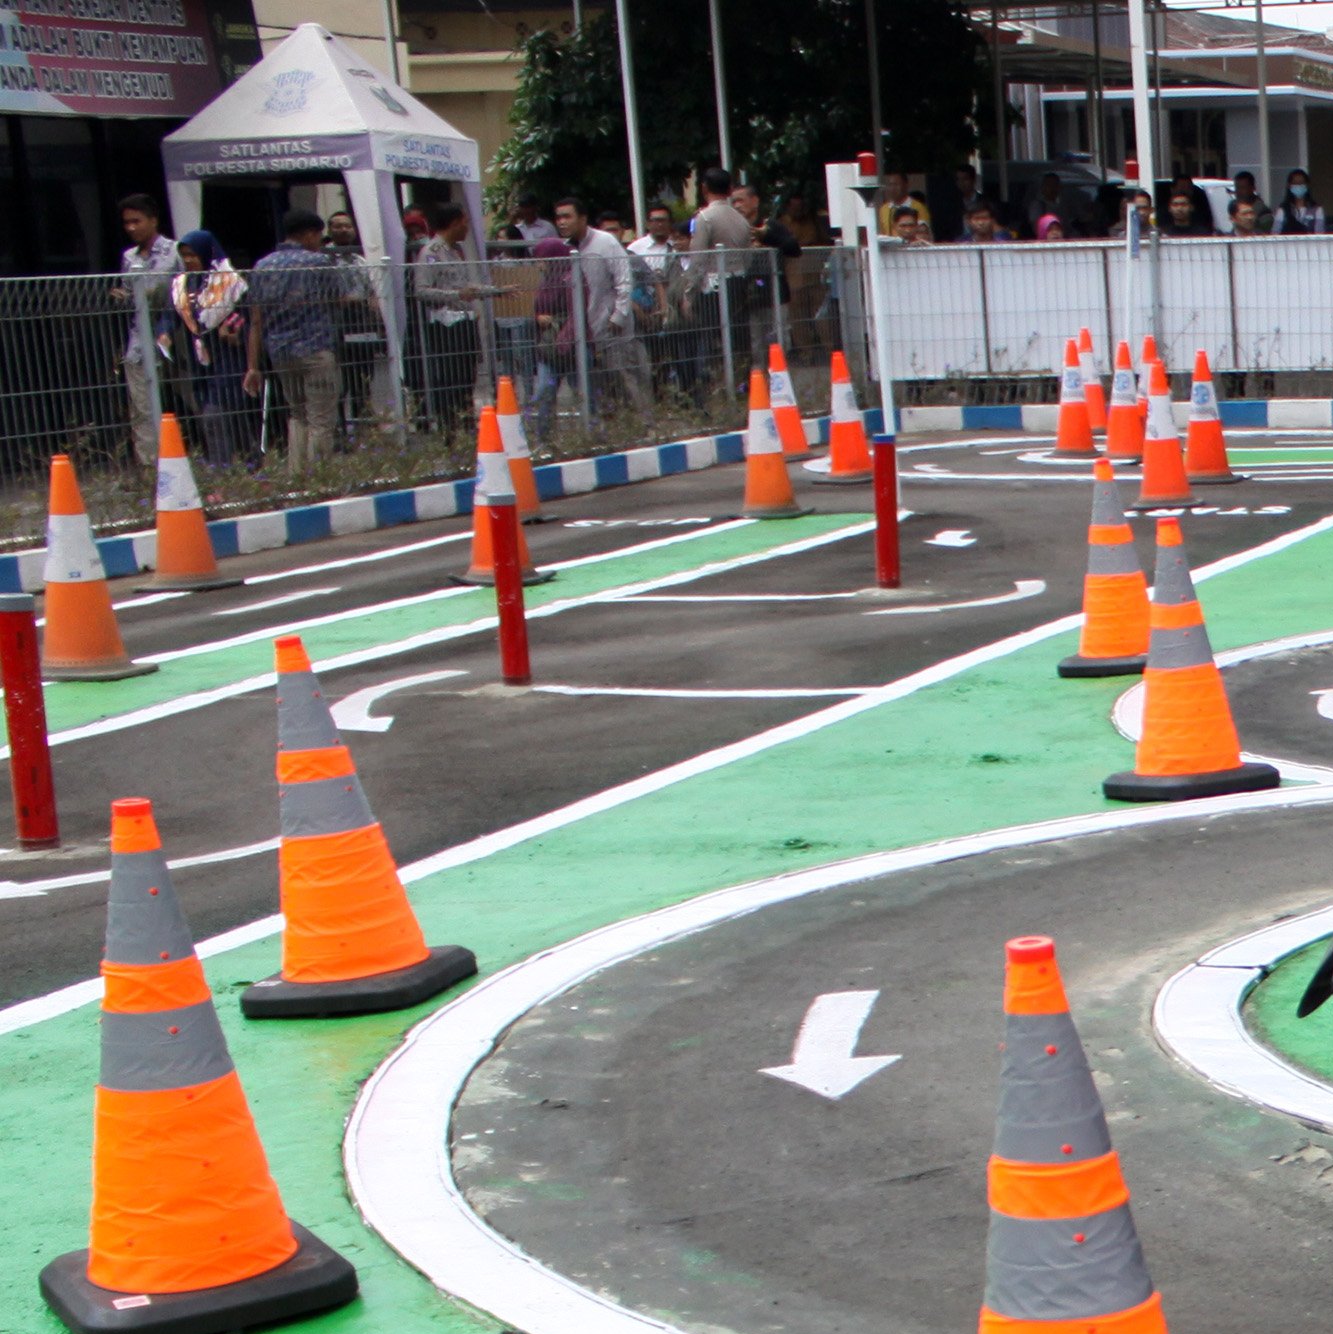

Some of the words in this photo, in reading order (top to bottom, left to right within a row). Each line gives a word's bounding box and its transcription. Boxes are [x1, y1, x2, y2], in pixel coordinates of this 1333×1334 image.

[71, 28, 120, 61] BUKTI
[119, 31, 208, 66] KEMAMPUAN
[220, 141, 311, 158] SATLANTAS
[403, 139, 451, 158] SATLANTAS
[184, 159, 266, 177] POLRESTA
[270, 154, 351, 171] SIDOARJO
[385, 153, 431, 171] POLRESTA
[431, 159, 471, 178] SIDOARJO
